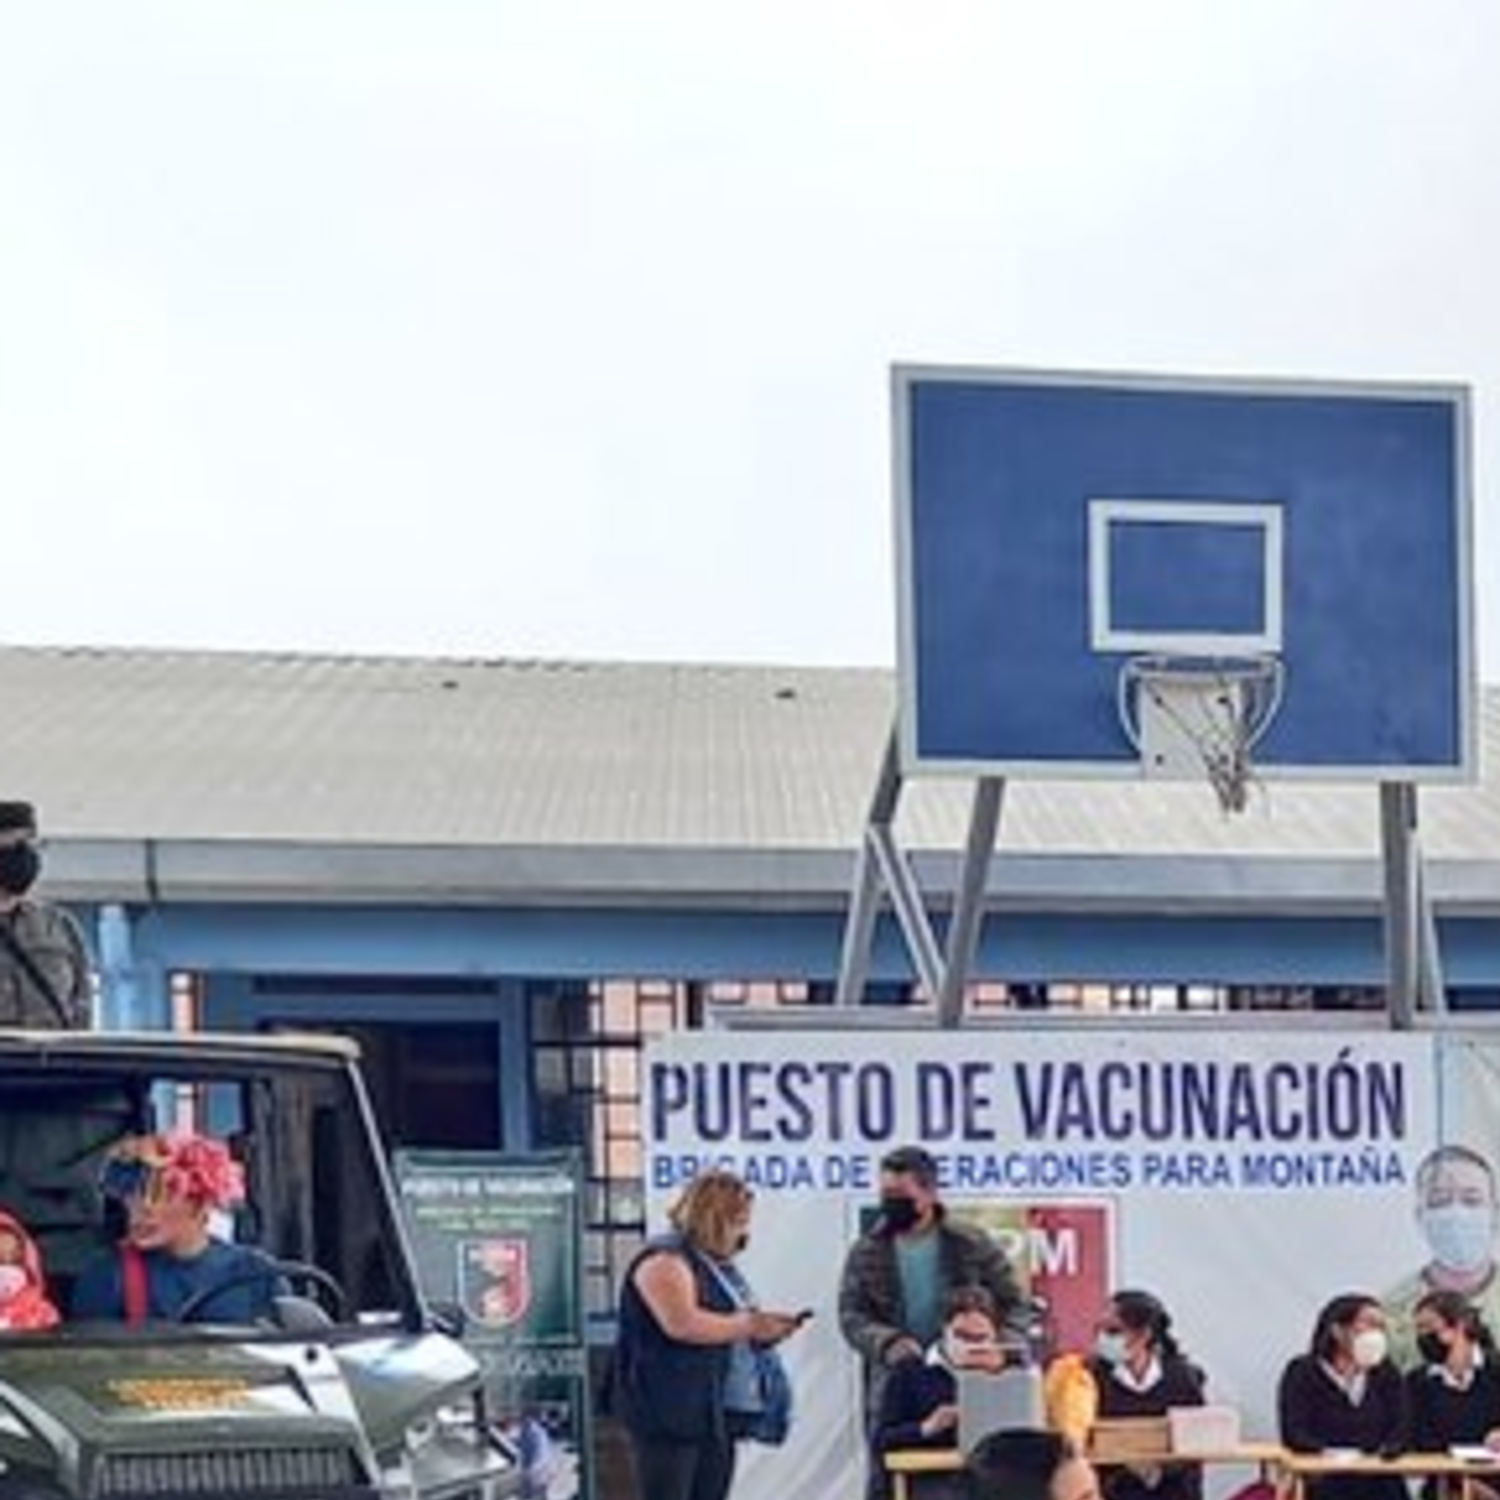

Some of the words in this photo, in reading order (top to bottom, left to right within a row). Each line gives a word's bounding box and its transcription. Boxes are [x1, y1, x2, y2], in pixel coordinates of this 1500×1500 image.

[650, 1060, 894, 1142] PUESTO
[916, 1060, 996, 1142] DE
[1014, 1045, 1406, 1142] VACUNACIÓN
[654, 1155, 814, 1188] BRADA
[827, 1155, 870, 1188] DE
[937, 1154, 1132, 1188] ERACIONES
[1142, 1154, 1232, 1187] PARA
[1242, 1145, 1405, 1188] MONTAÑA
